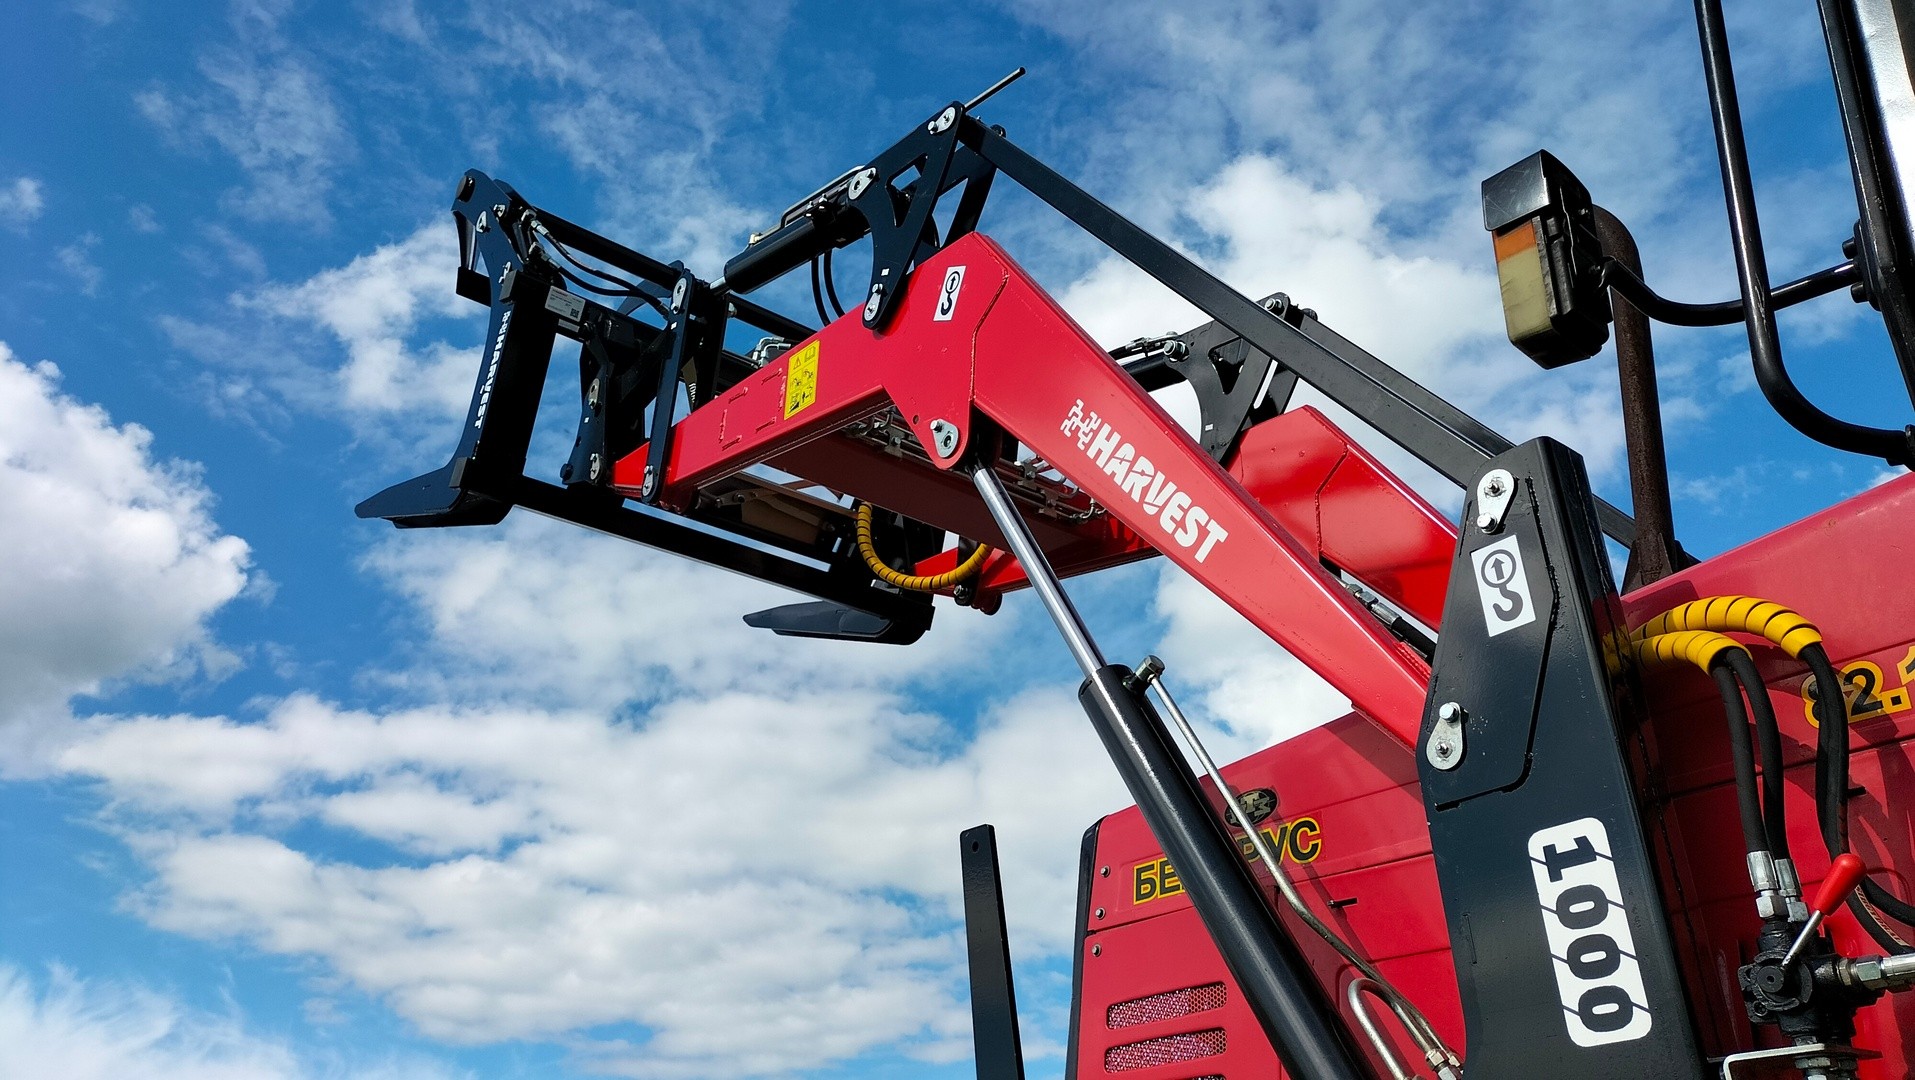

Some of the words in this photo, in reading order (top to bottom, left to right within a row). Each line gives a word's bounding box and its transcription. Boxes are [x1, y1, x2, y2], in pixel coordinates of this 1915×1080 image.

[475, 334, 505, 429] HARVEST
[1086, 423, 1229, 564] HARVEST
[1134, 817, 1322, 905] БЕРУС
[1543, 836, 1634, 1033] 1000
